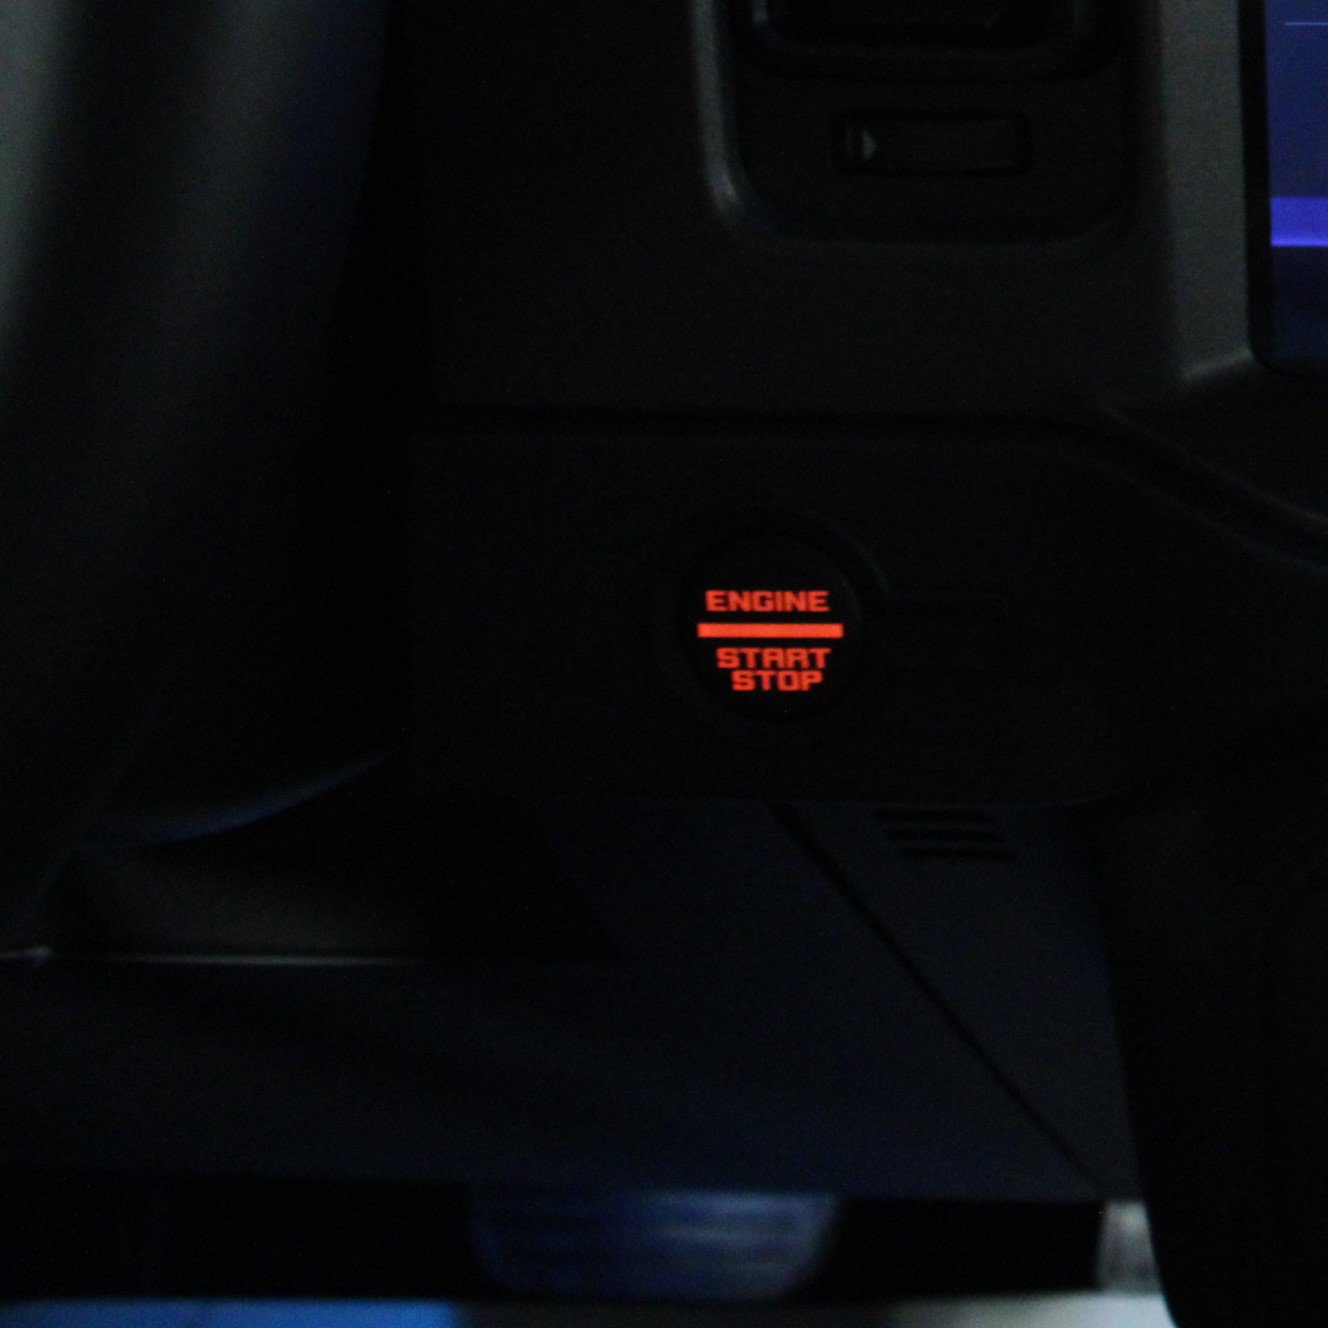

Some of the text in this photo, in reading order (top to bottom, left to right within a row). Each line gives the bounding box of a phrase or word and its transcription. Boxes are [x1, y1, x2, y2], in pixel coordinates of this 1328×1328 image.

[705, 589, 831, 613] ENGINE
[716, 647, 832, 669] START
[731, 669, 824, 692] STOP
